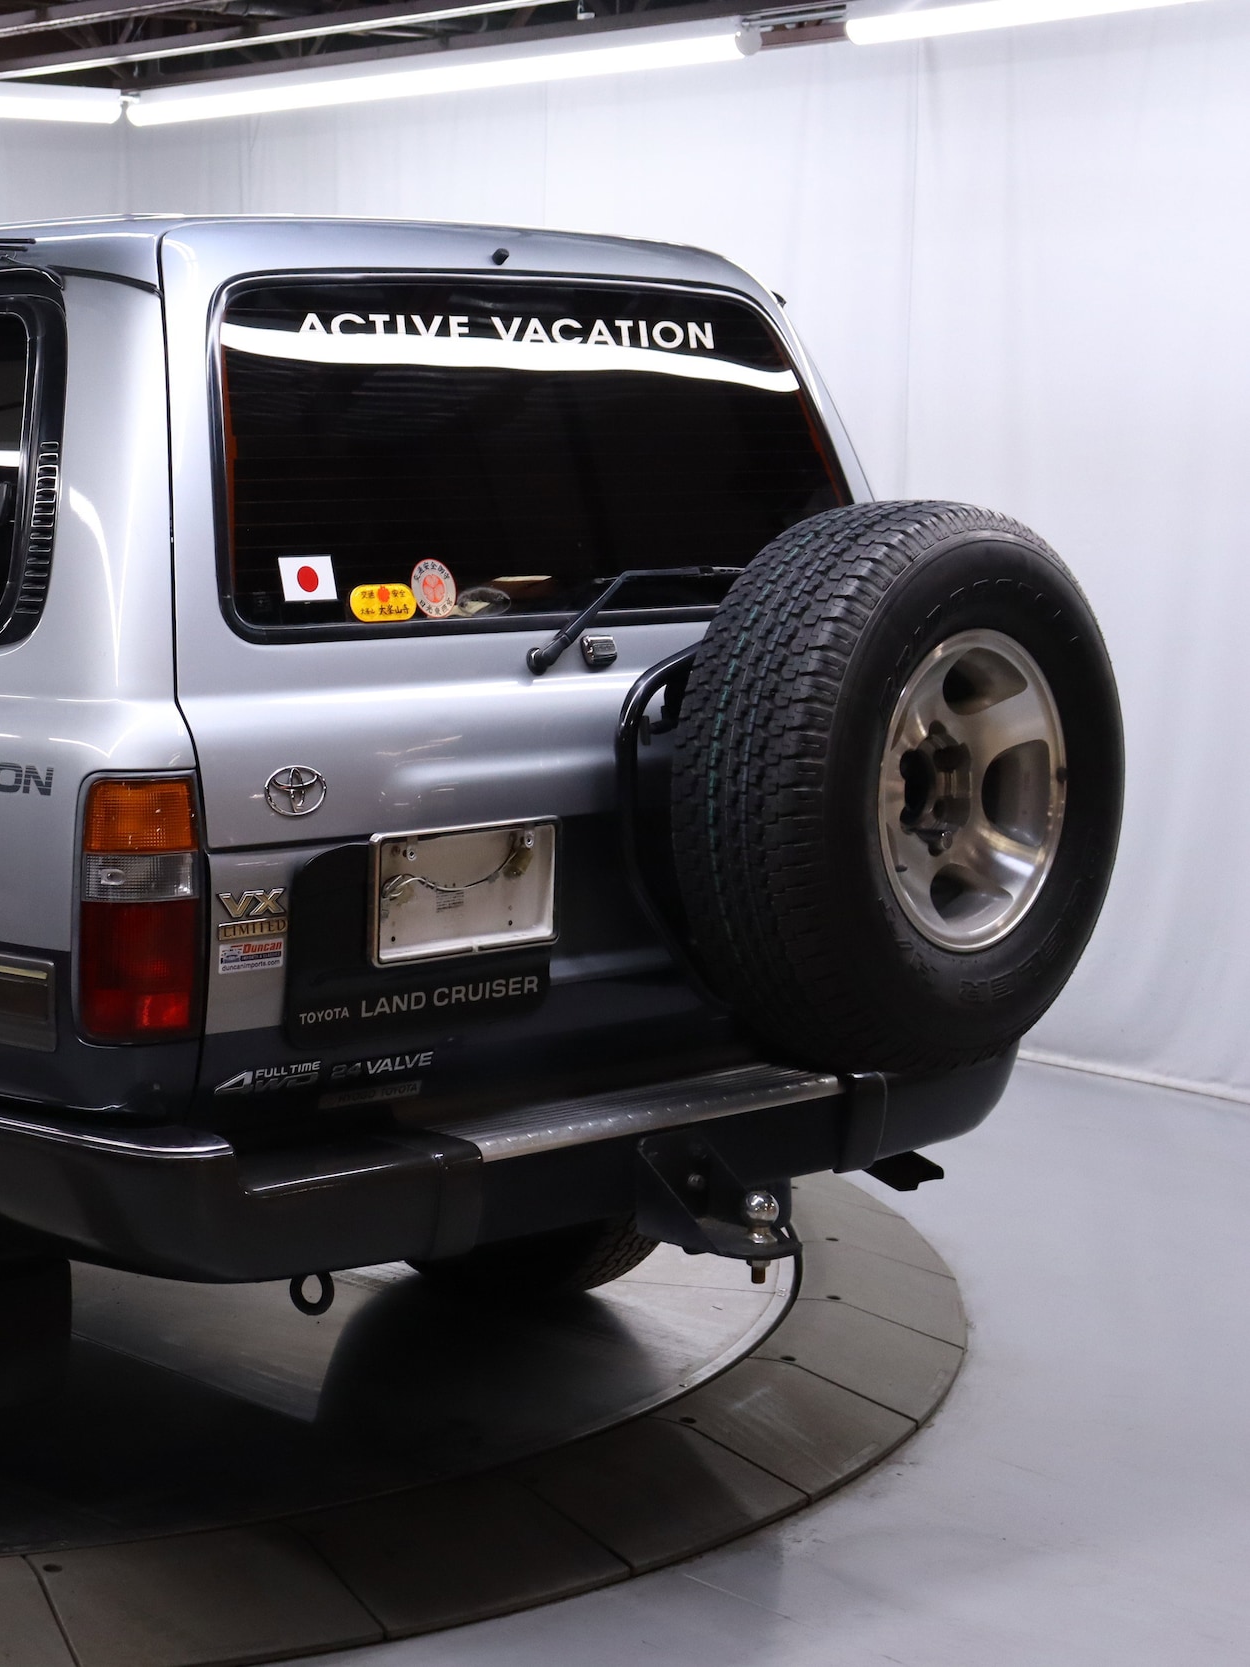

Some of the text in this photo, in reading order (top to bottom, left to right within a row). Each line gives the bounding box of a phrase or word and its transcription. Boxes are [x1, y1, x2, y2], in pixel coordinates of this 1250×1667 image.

[298, 312, 716, 350] ACTIVE VACATION
[217, 887, 286, 918] VX
[222, 919, 287, 938] LIMITED
[242, 941, 283, 954] Duncan
[221, 960, 281, 972] duncanimports.com
[299, 975, 539, 1025] TOYOTA LAND CRUISER
[255, 1060, 322, 1079] FULL TIME
[330, 1051, 435, 1080] 24 VALVE
[213, 1069, 320, 1095] 4WD
[380, 1082, 418, 1097] TOYOTA
